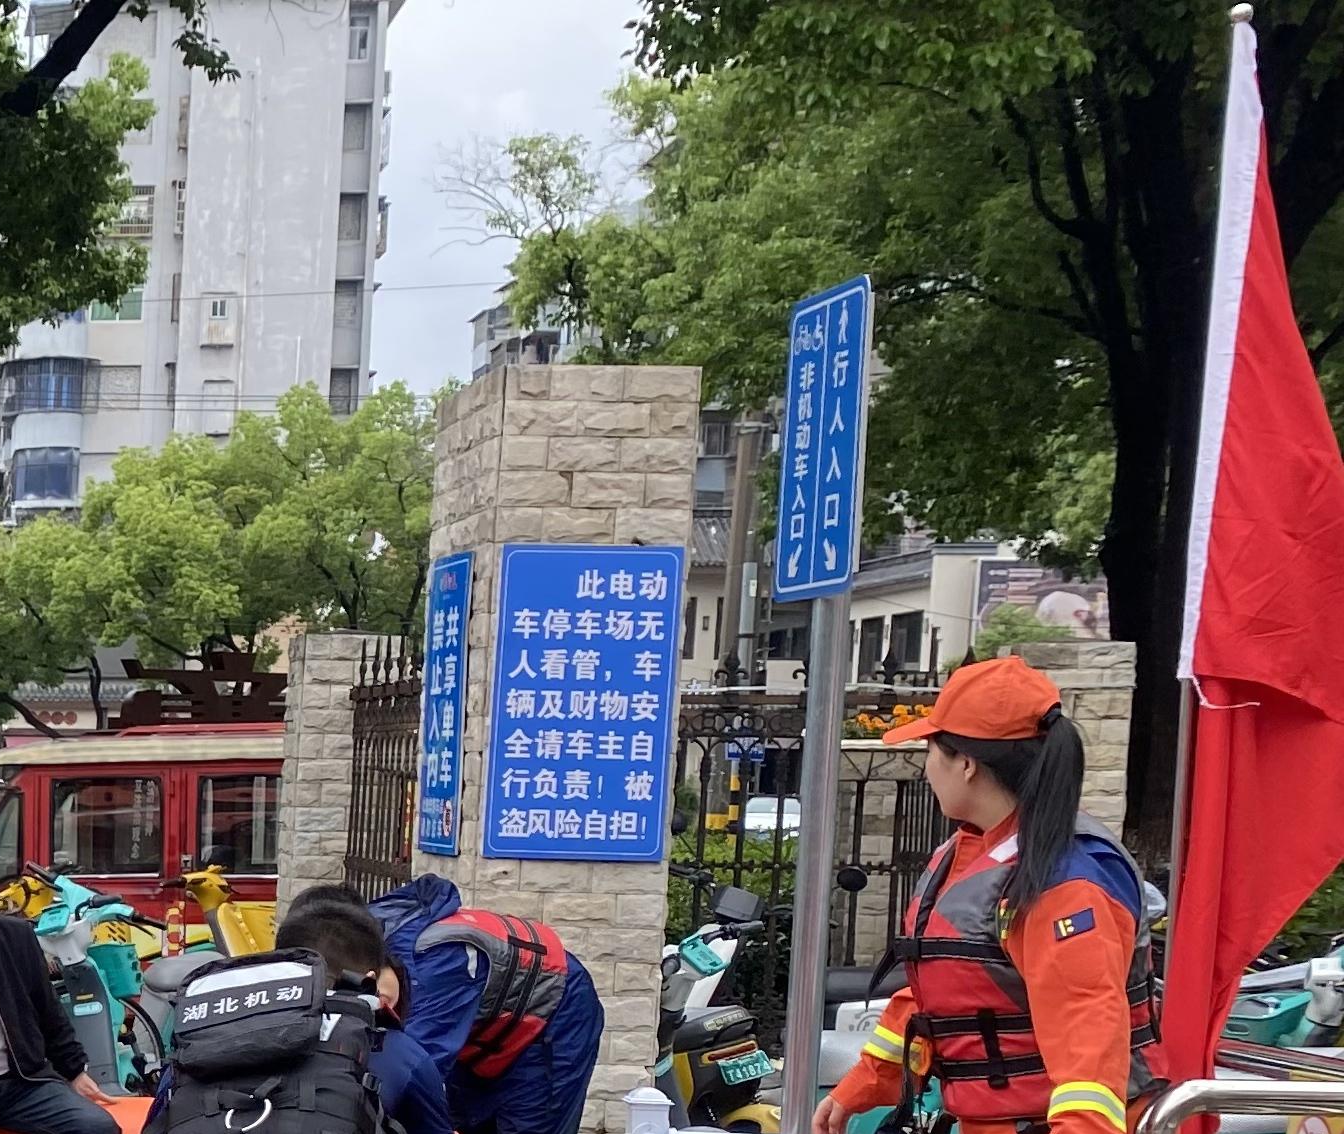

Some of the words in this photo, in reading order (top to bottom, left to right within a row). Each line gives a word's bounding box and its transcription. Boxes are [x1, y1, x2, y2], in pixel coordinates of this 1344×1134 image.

[790, 361, 815, 541] 非机动车入口
[823, 350, 849, 529] 行人入口
[576, 569, 668, 601] 此电动
[512, 608, 665, 641] 车停车场无
[426, 609, 445, 788] 禁止入内
[439, 605, 460, 788] 共享单车
[505, 689, 660, 721] 辆及财物安
[503, 729, 654, 762] 全请车主自
[182, 985, 303, 1023] 湖北机动
